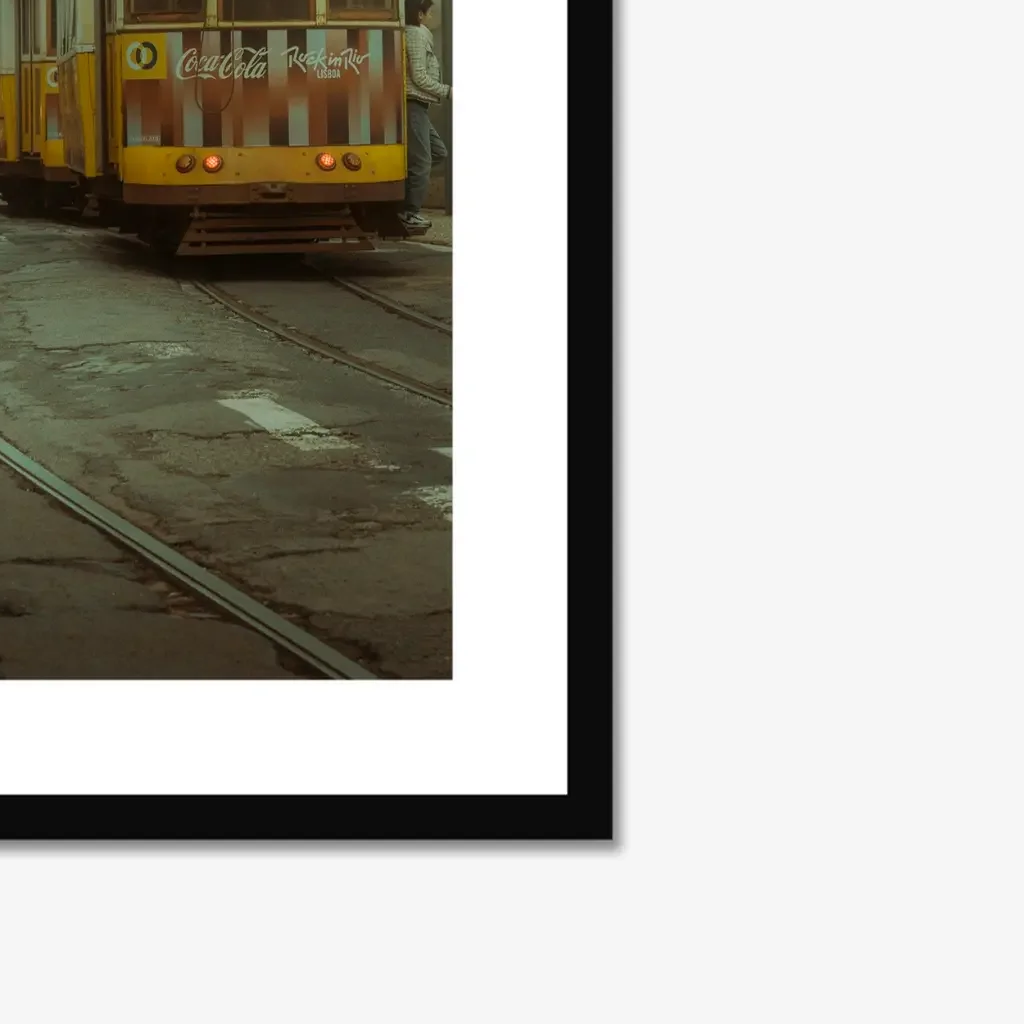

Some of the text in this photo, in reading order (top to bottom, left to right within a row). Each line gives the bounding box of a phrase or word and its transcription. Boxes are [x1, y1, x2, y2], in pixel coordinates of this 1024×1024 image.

[280, 45, 371, 75] Rock in Rio
[316, 68, 341, 79] LISBOA
